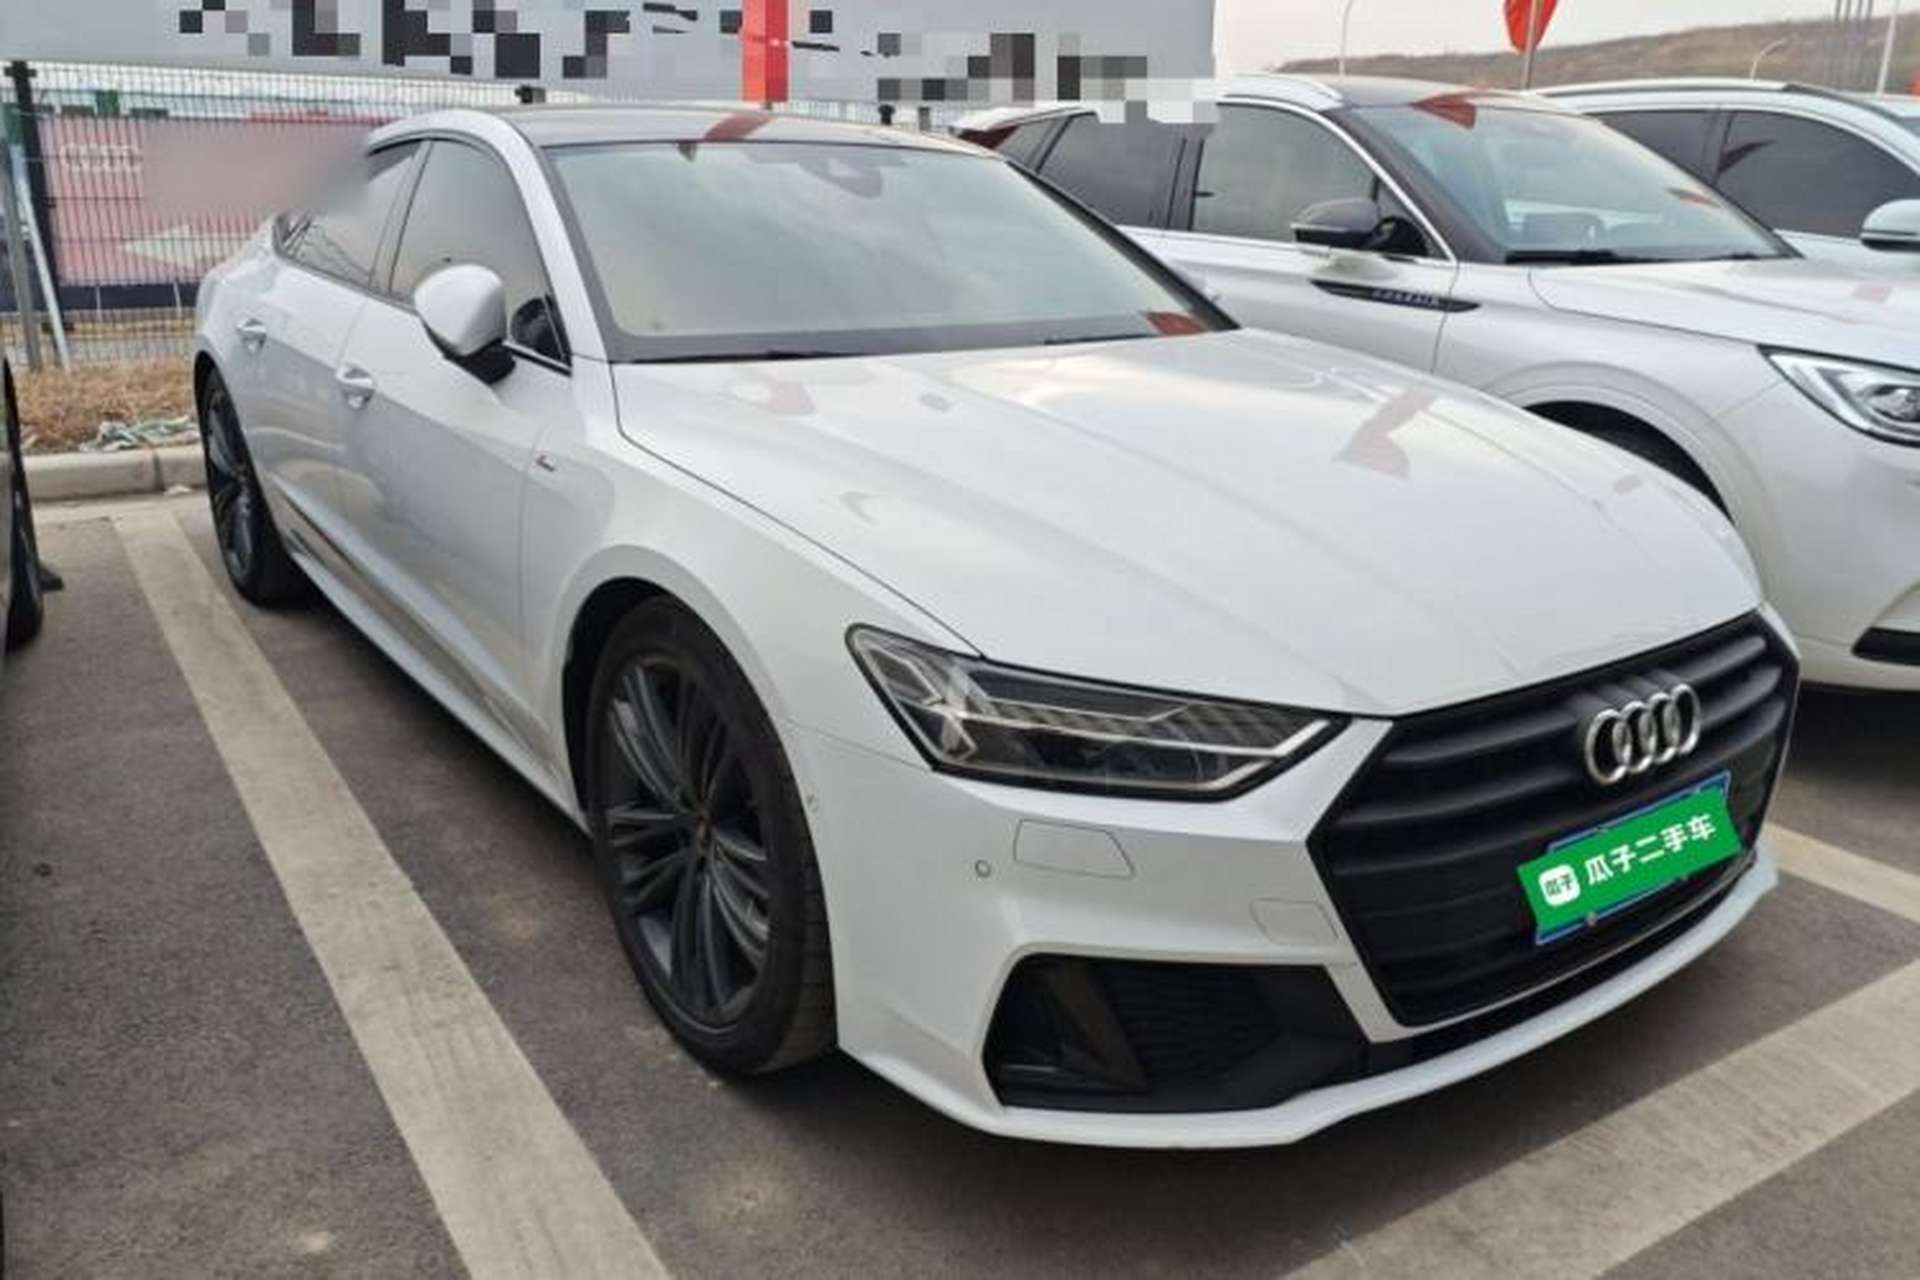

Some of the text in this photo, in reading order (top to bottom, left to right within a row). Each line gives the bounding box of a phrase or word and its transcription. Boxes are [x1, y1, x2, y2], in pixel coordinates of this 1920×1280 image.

[1584, 814, 1716, 885] 瓜子二手车
